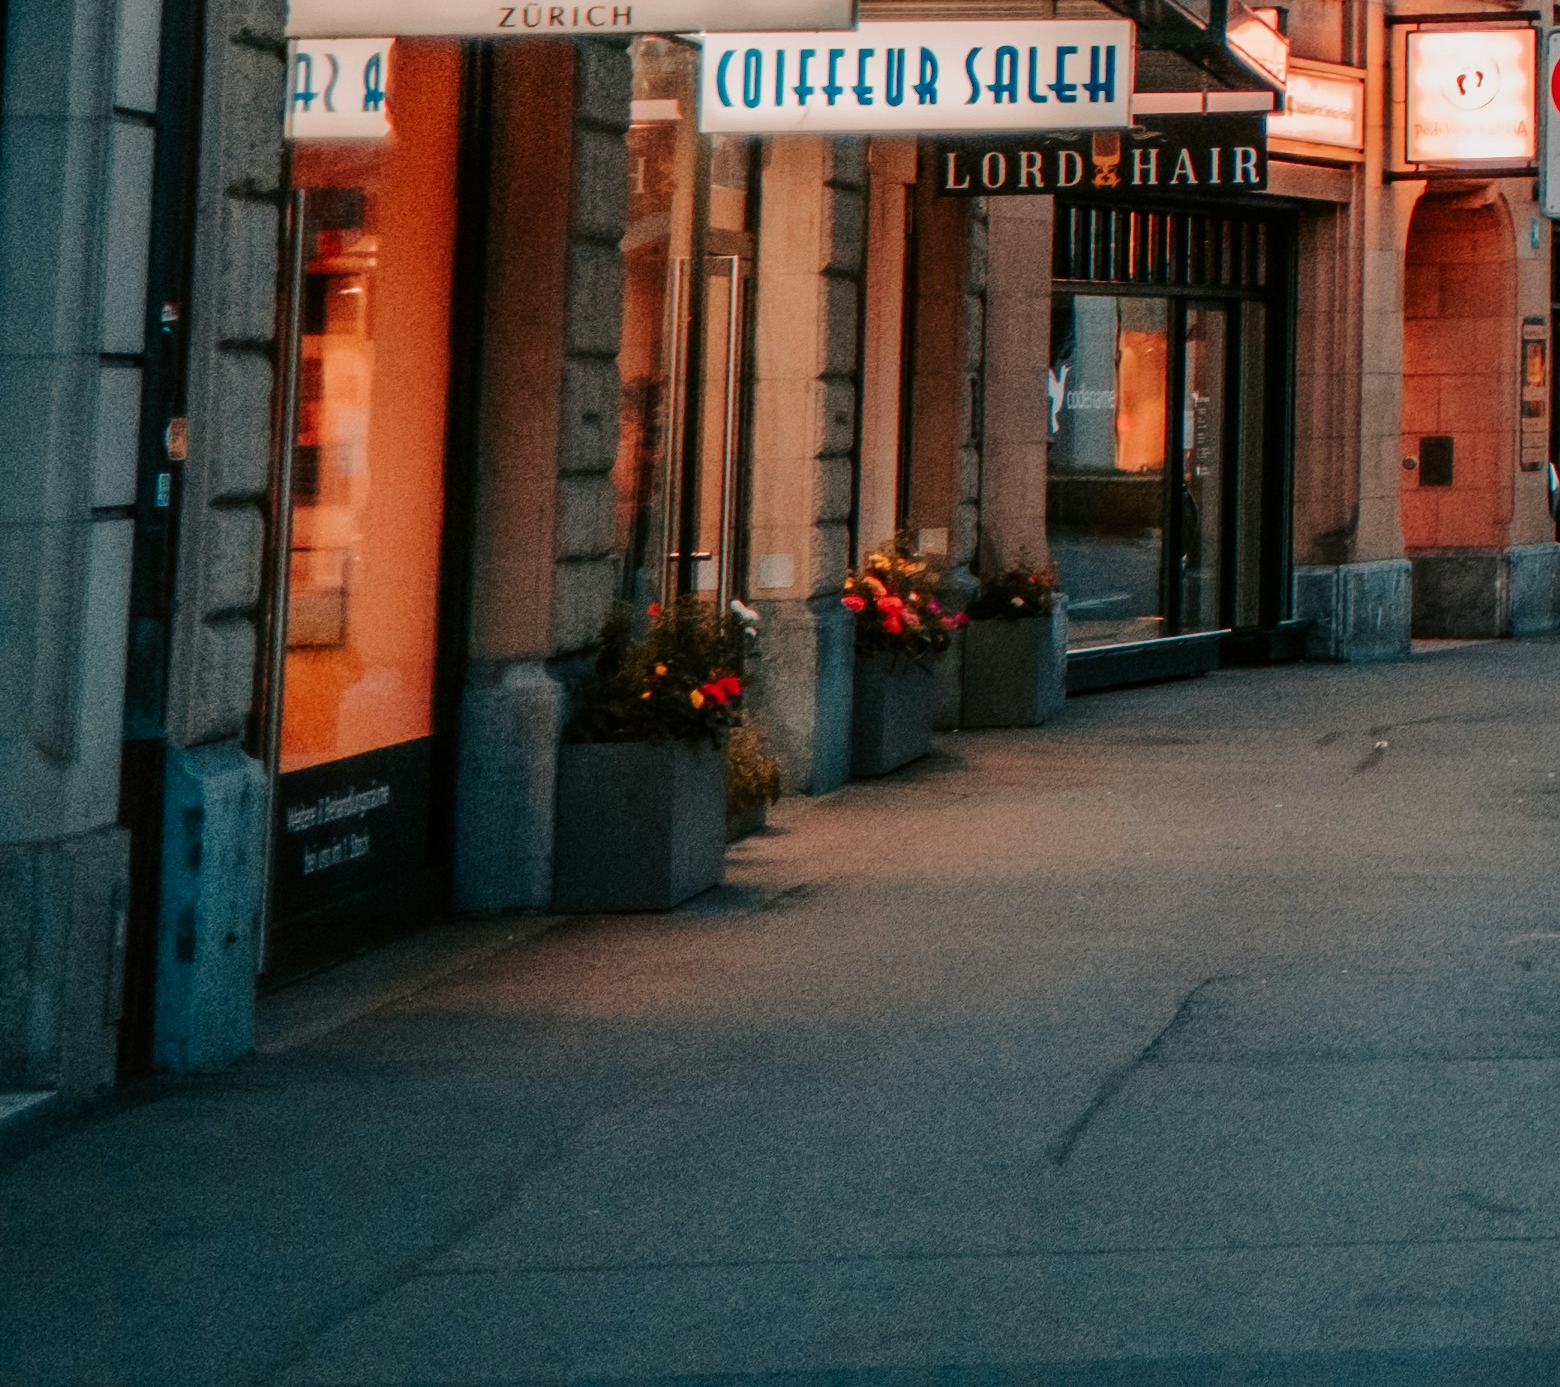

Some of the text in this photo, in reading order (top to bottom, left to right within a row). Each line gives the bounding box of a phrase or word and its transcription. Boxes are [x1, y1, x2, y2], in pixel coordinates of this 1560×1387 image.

[498, 4, 633, 28] ZÜRICH
[717, 45, 1117, 109] COIFFEUR SALEH
[945, 145, 1261, 190] LORD HAIR
